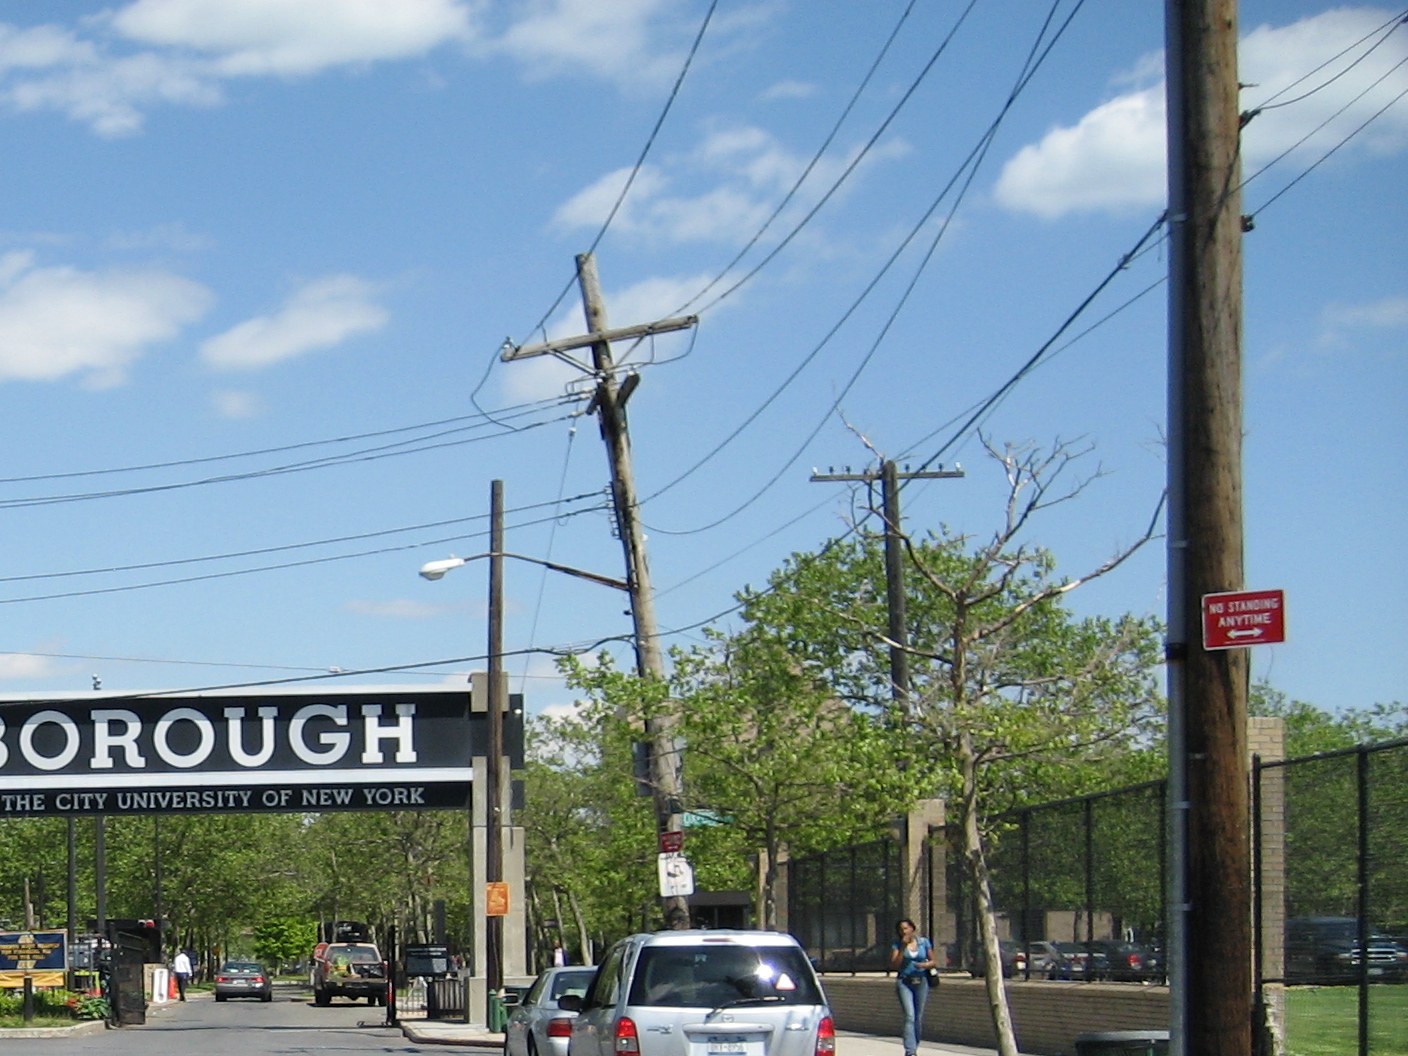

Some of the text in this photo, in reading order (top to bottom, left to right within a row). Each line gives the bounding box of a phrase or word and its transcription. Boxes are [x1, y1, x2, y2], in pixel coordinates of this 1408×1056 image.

[1209, 598, 1279, 614] NO STANDING
[1218, 613, 1271, 627] ANYTIME
[1, 787, 425, 811] THE CITY UNIVERSITY OF NEW YORK
